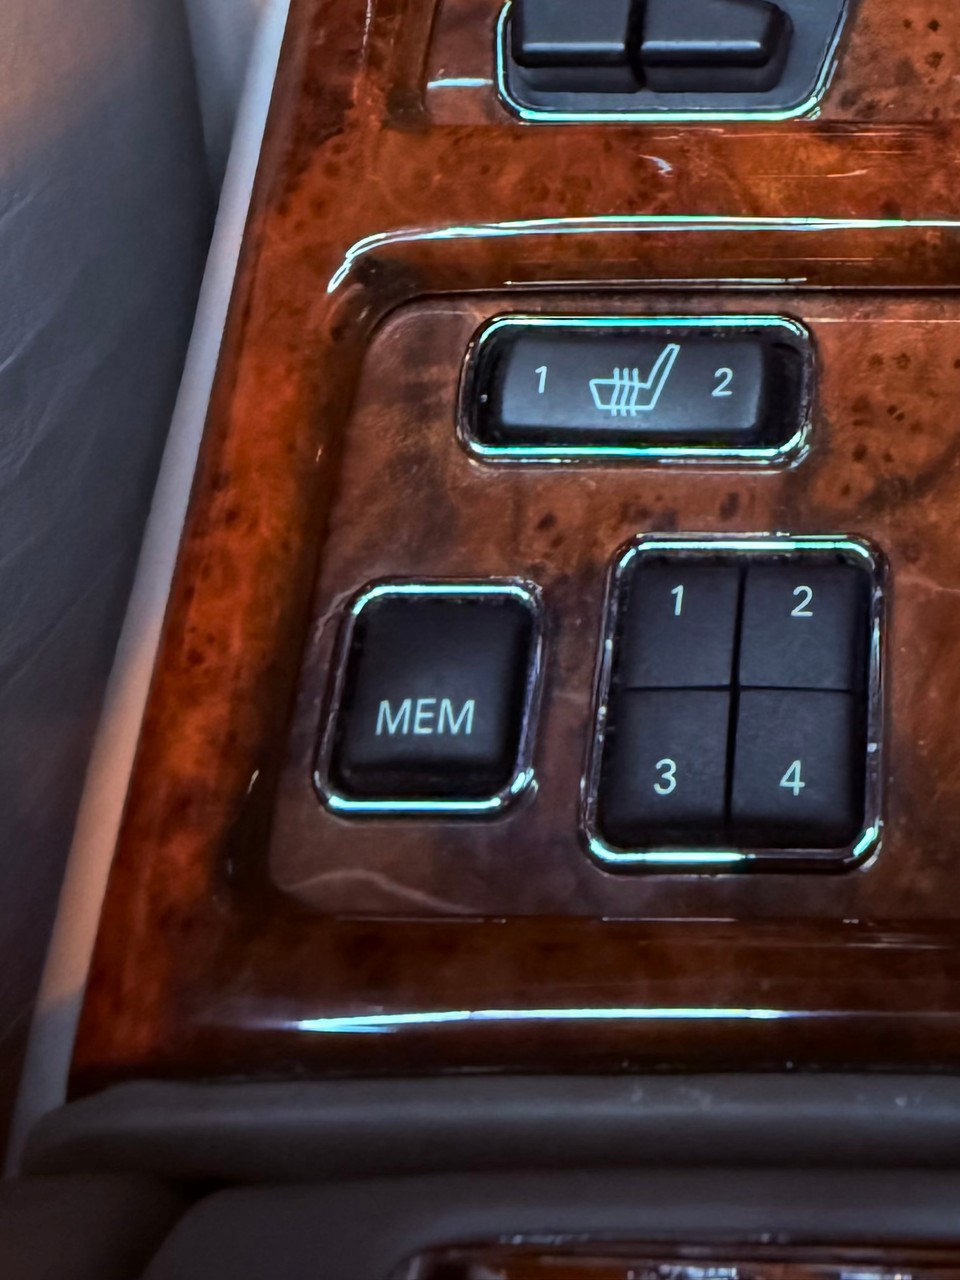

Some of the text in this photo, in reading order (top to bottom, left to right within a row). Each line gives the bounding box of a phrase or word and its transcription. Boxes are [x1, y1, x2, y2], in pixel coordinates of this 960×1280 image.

[535, 365, 733, 397] 1 2
[671, 585, 813, 617] 1 2
[376, 698, 475, 735] MEM
[653, 758, 806, 796] 3 4
